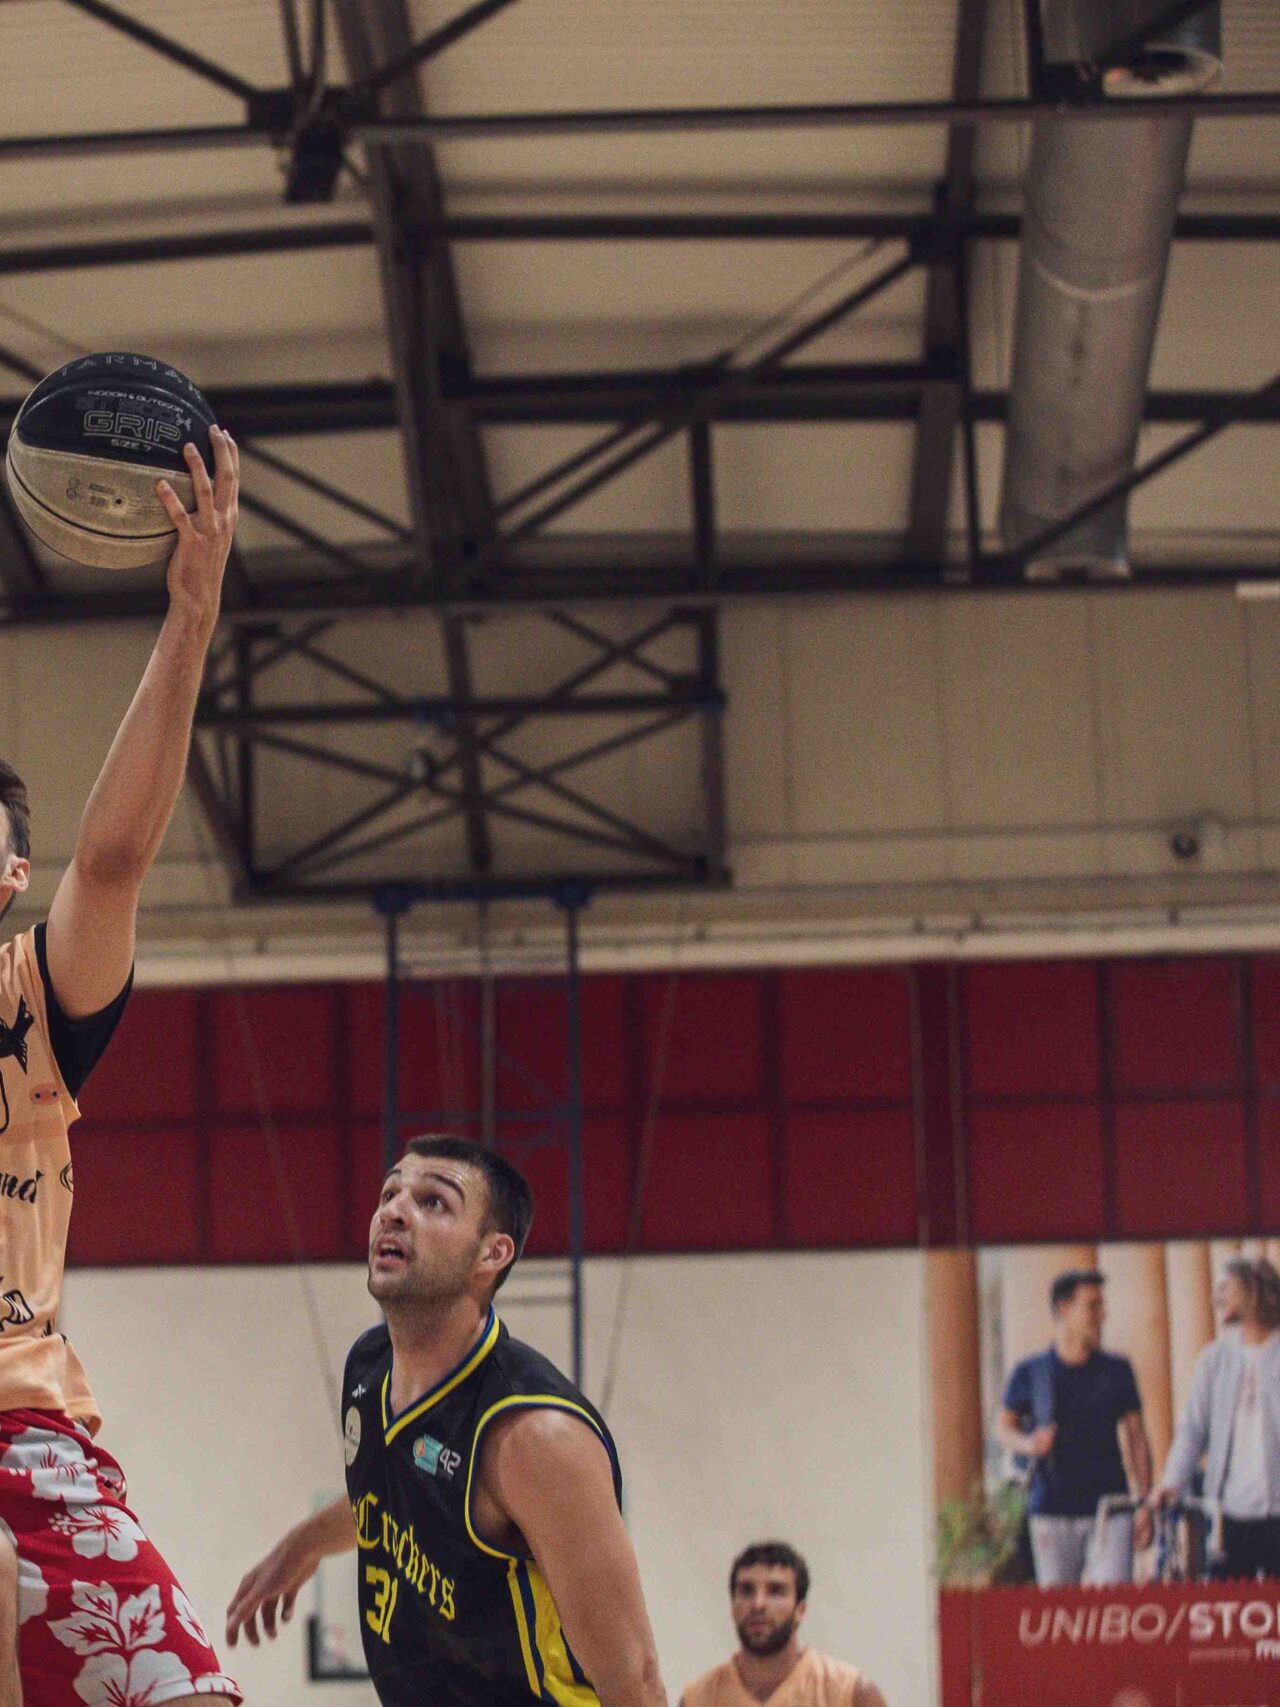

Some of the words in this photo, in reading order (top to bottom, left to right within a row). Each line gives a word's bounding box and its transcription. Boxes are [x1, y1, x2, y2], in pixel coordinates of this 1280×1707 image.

[83, 409, 182, 443] GRIP
[110, 438, 140, 450] SIZE
[365, 1564, 399, 1645] 31
[1018, 1600, 1280, 1647] UNIBO/STO
